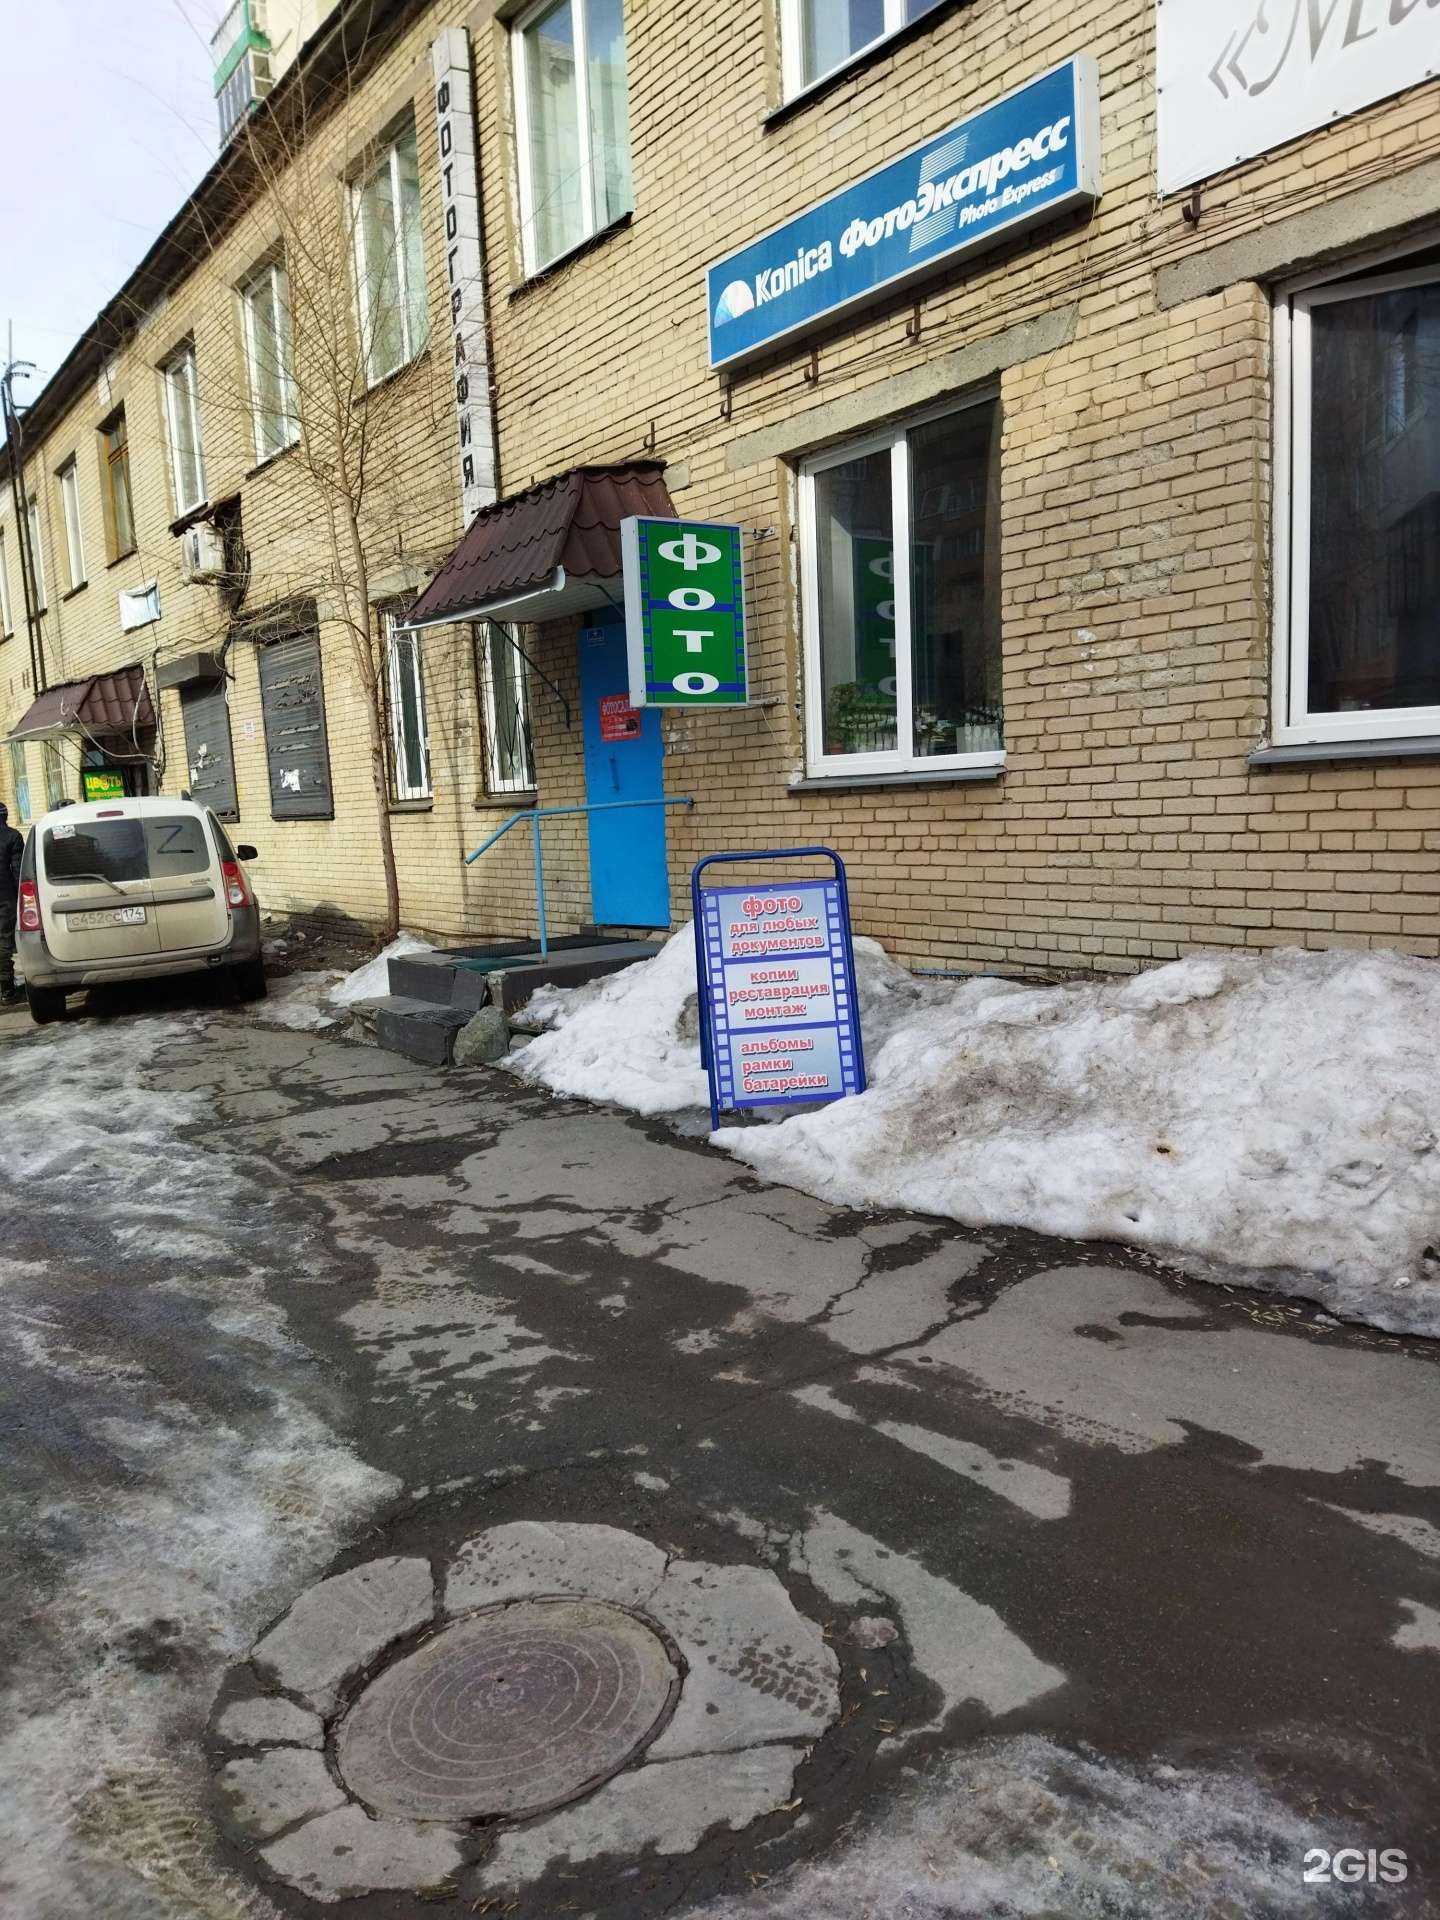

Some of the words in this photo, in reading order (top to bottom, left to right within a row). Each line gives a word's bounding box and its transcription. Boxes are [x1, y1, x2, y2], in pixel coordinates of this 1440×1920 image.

[959, 197, 999, 229] Photo
[1001, 168, 1058, 206] Express
[755, 240, 833, 307] Konica
[437, 81, 475, 488] ФОТОГРАФИЯ
[154, 824, 195, 854] Z
[122, 907, 144, 920] 174
[741, 895, 803, 918] фото
[730, 920, 759, 937] для
[762, 917, 818, 934] любых
[731, 933, 824, 956] документов
[750, 968, 799, 984] копии
[728, 983, 830, 1004] реставрация
[744, 1003, 807, 1021] монтаж
[740, 1038, 814, 1055] альбомы
[742, 1058, 793, 1076] рамки
[743, 1074, 829, 1093] батарейки
